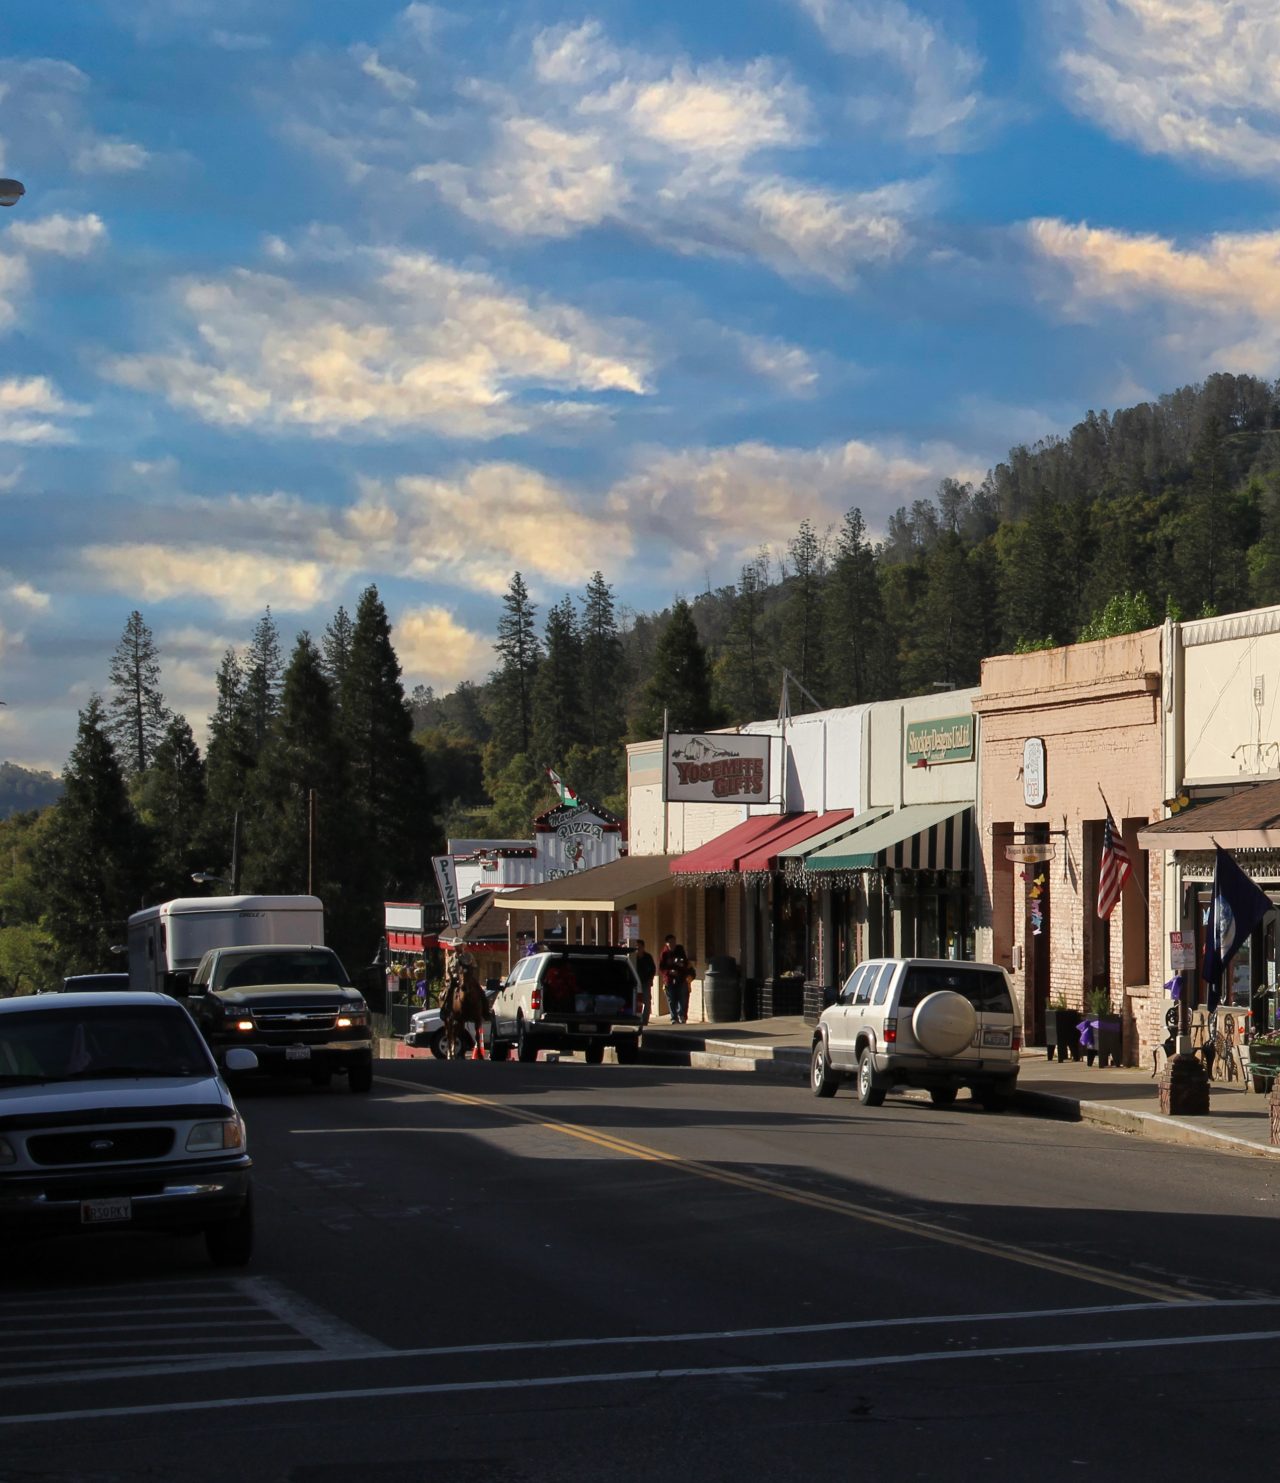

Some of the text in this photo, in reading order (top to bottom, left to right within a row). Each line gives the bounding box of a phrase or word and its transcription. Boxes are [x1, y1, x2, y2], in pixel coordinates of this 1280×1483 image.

[672, 757, 763, 785] YOSEMITE
[712, 775, 763, 798] GIFTS
[558, 822, 604, 842] PIZZA
[1172, 934, 1182, 942] NO
